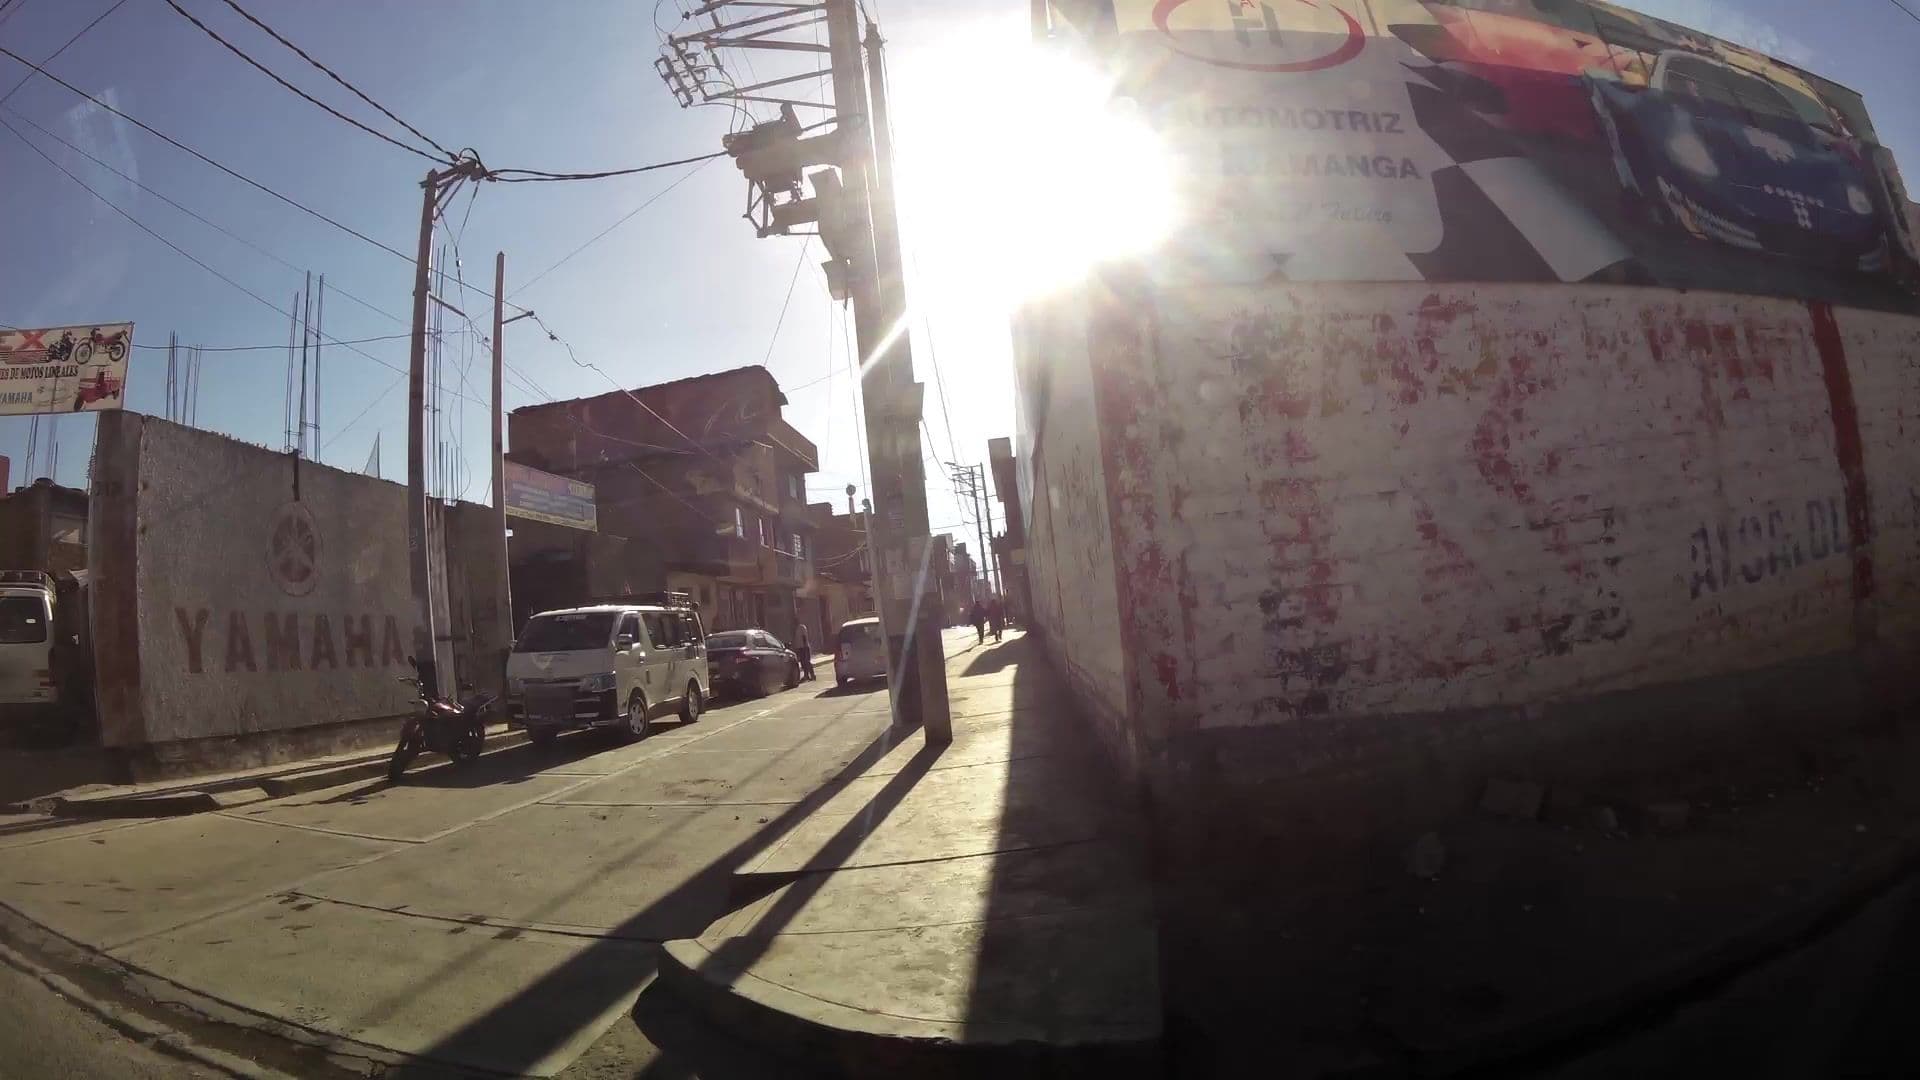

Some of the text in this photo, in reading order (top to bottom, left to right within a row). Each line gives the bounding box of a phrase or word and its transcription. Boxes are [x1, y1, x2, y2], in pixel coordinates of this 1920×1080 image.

[1176, 107, 1404, 134] UTOMOTRIZ
[10, 367, 20, 380] DE
[21, 366, 44, 379] MOTOS
[174, 607, 405, 674] YAMAHA
